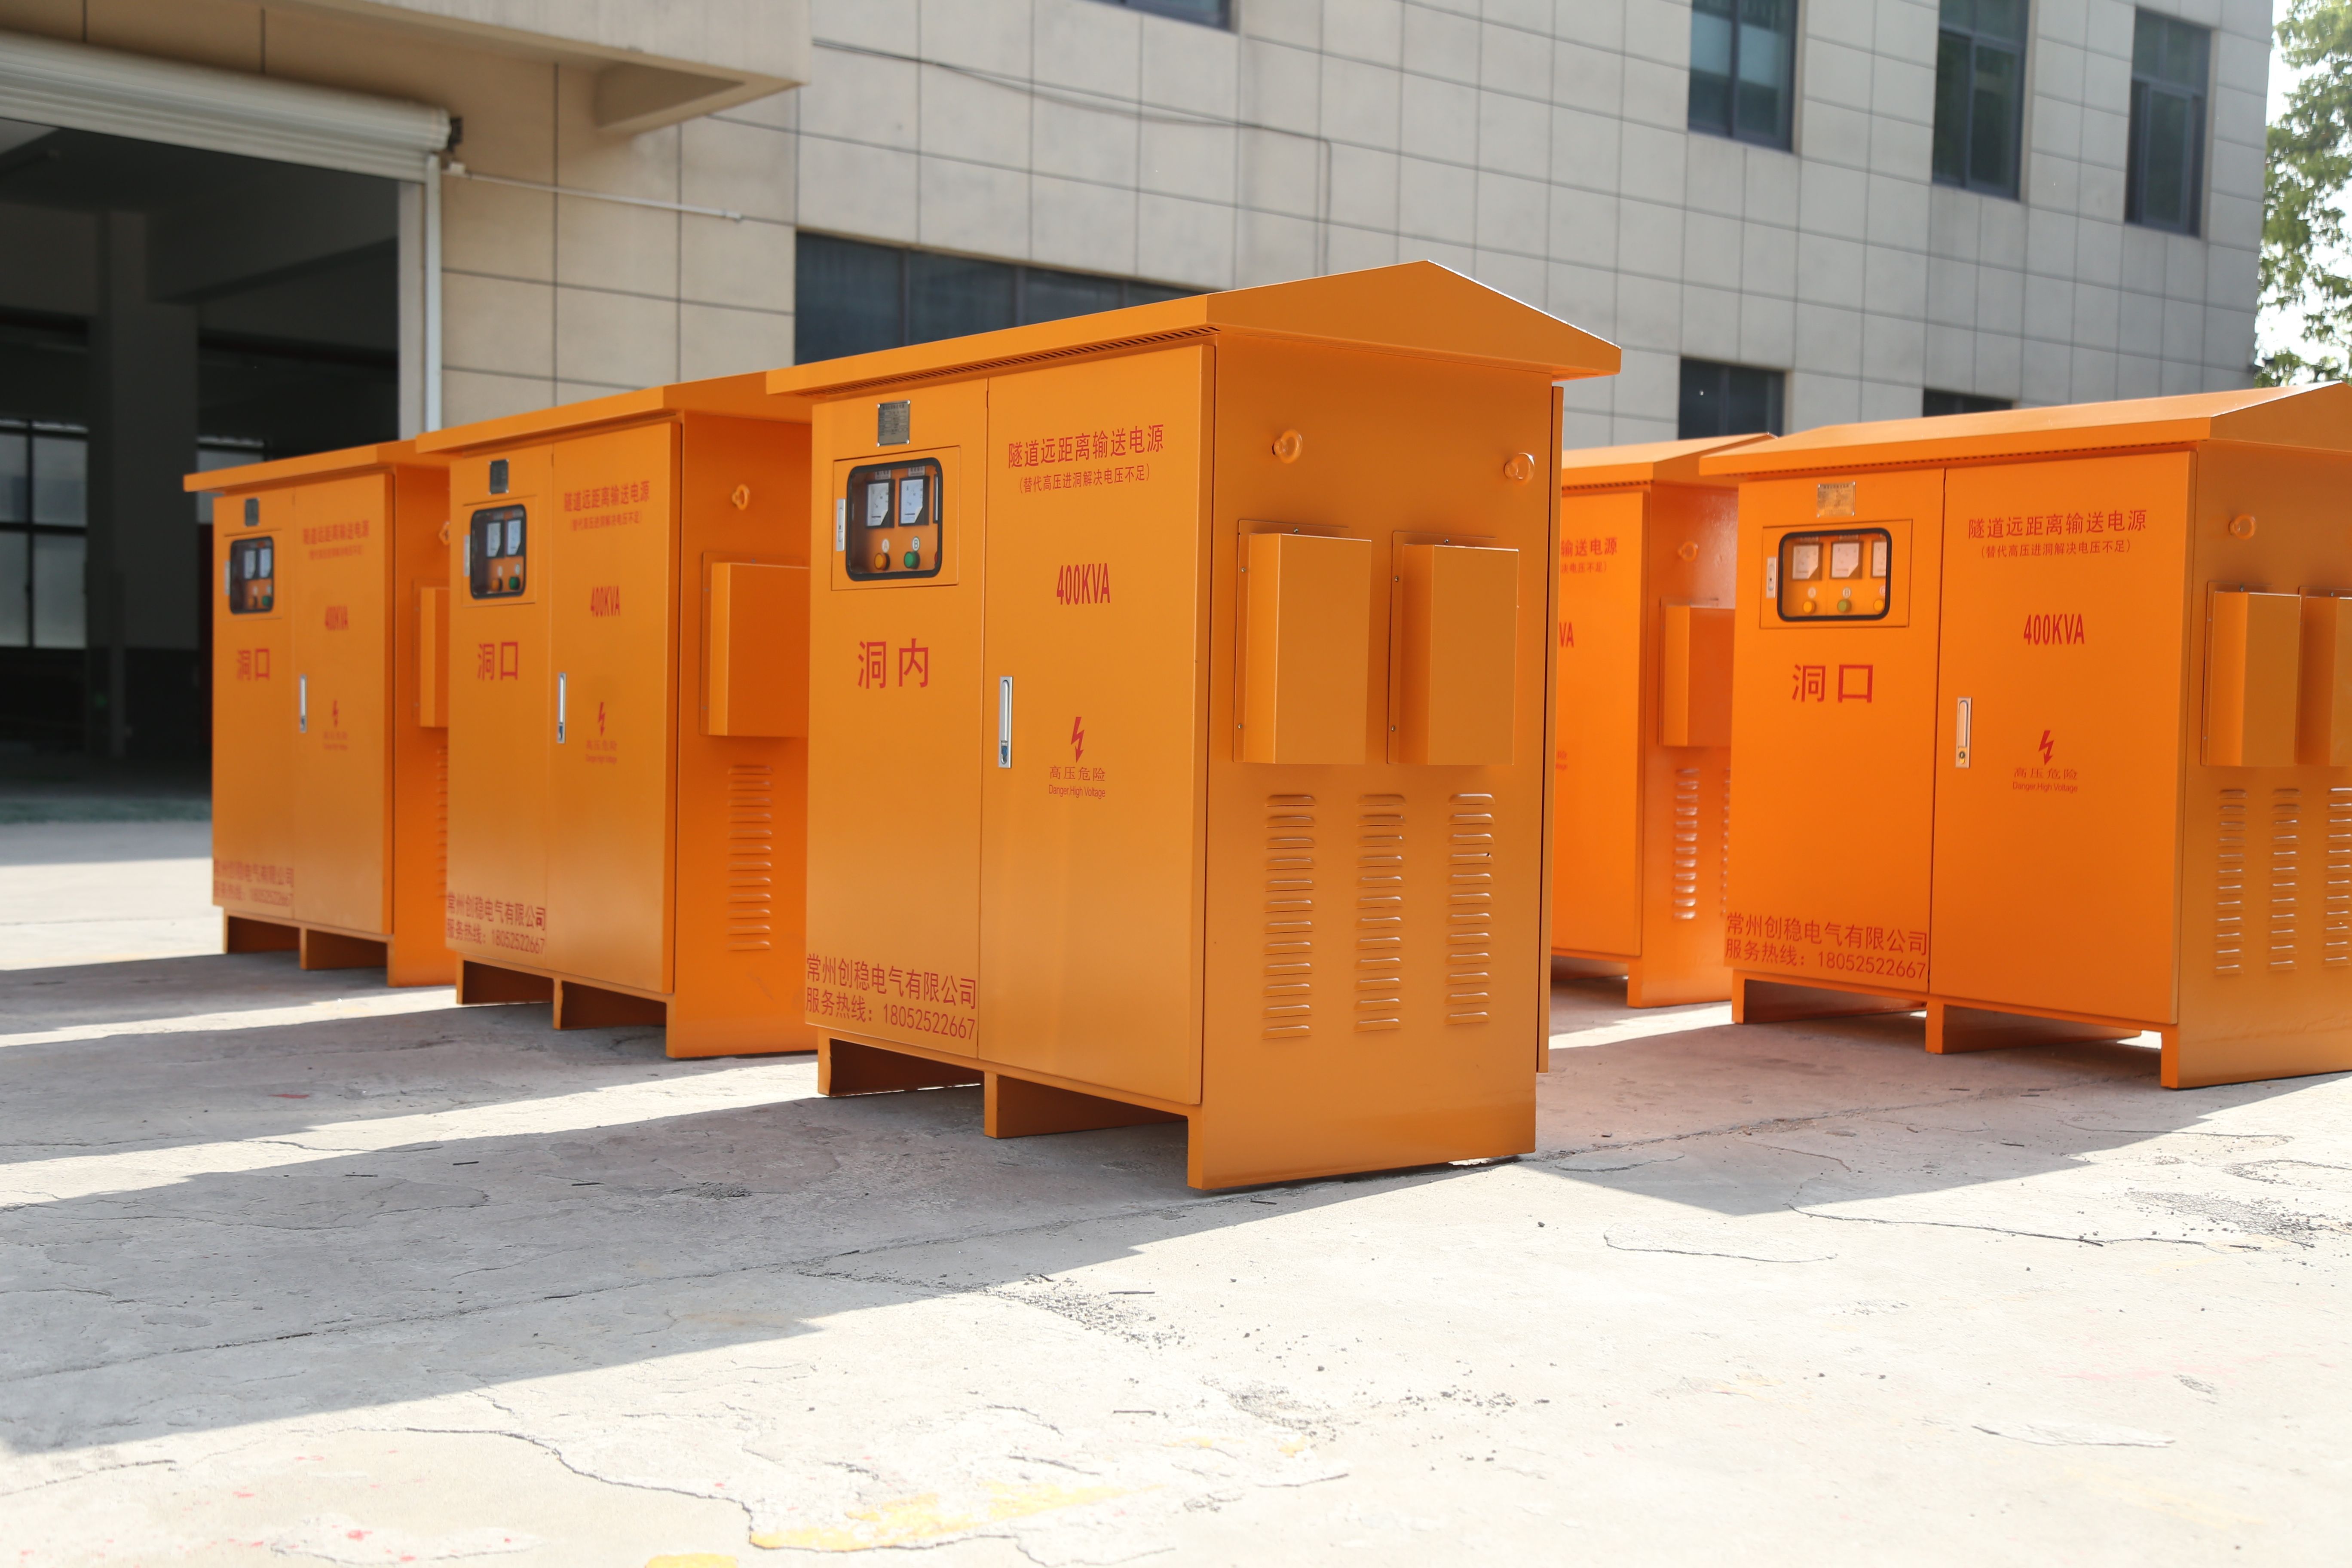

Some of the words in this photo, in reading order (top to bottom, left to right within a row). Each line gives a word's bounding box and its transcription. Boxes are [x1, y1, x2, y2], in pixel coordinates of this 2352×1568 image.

[1008, 424, 1164, 469] 隧道远距离输送电源
[1968, 509, 2147, 539] 隧道远距离输送电源
[590, 585, 621, 618] 400KVA
[1056, 563, 1111, 606] 400KVA
[2023, 614, 2085, 646] 400KVA
[477, 641, 519, 681] 洞口
[858, 638, 929, 689] 洞内
[1792, 664, 1874, 704] 洞口
[1049, 765, 1106, 782] 高压危险
[1084, 786, 1106, 800] Voltage
[1727, 911, 1927, 957] 常州创稳电气有限公司
[806, 953, 977, 1010] 常州创稳电气有限公司
